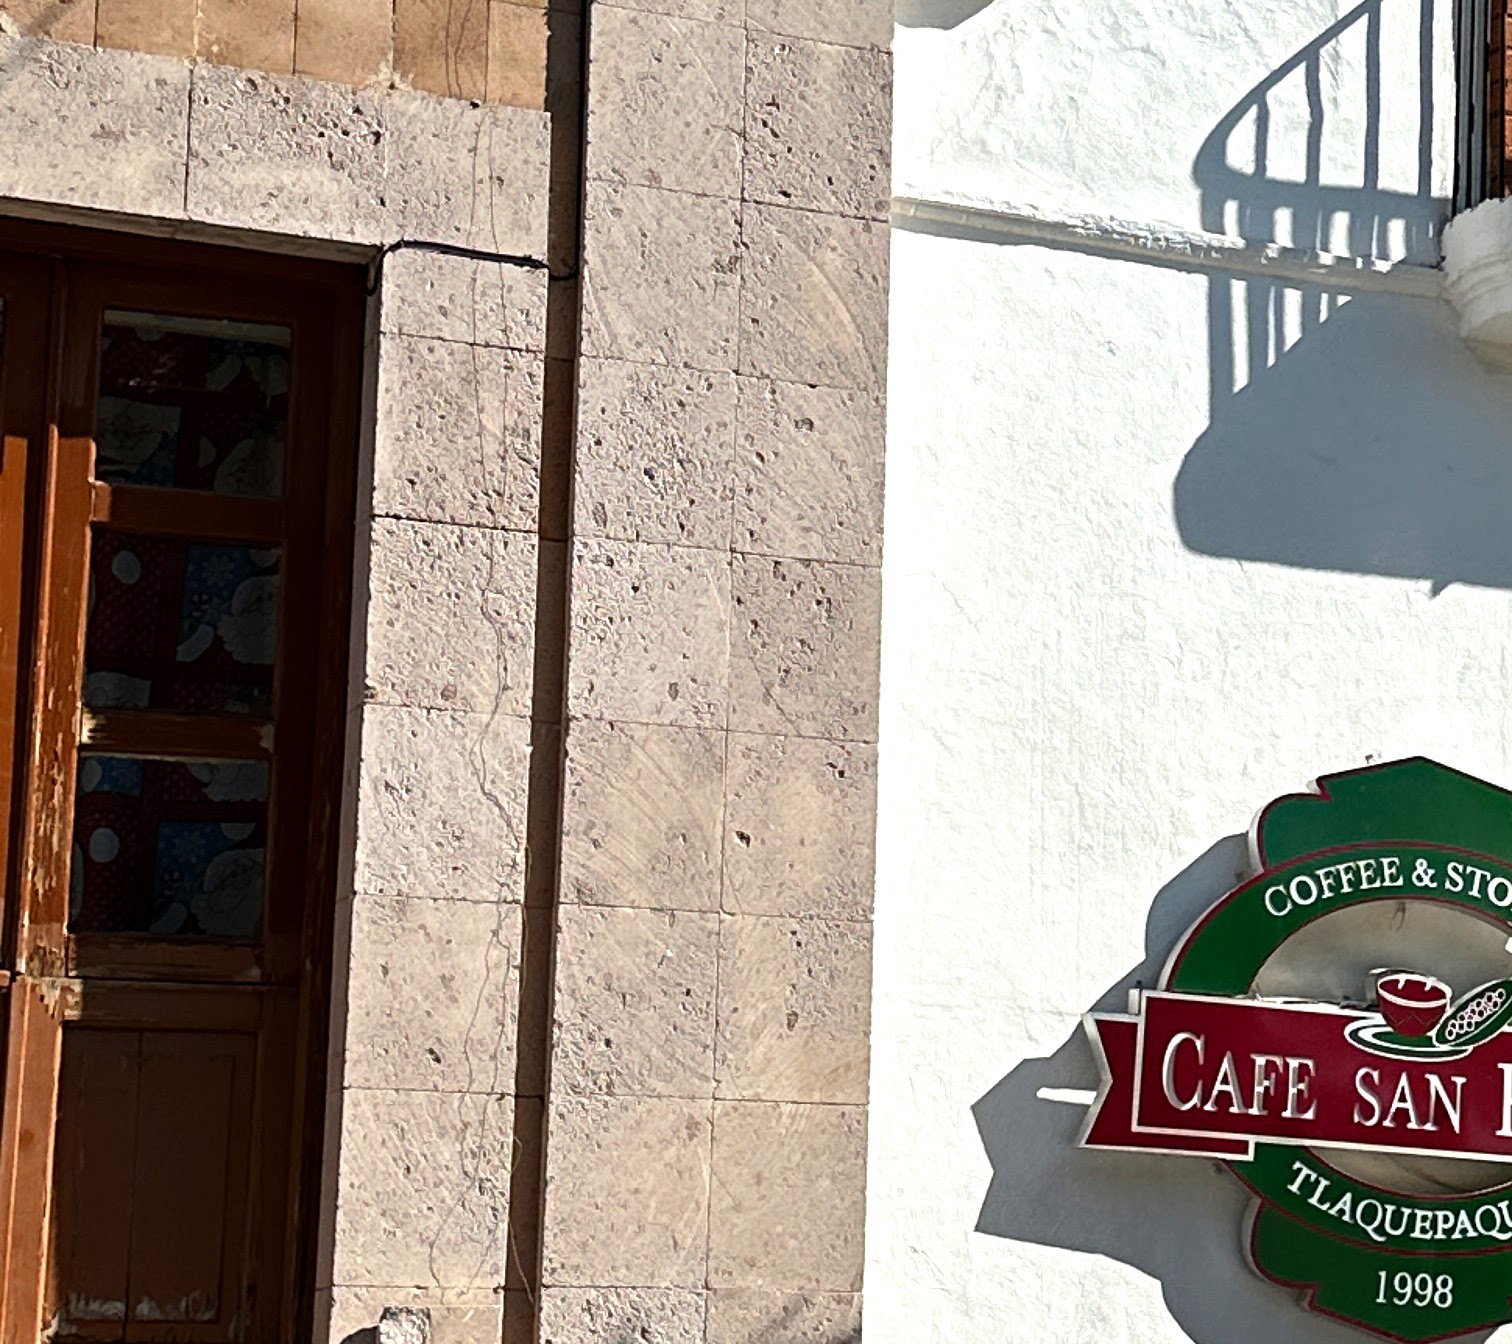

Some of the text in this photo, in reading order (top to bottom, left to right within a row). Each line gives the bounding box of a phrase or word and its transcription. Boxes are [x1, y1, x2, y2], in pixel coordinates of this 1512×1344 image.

[1264, 858, 1404, 917] COFFEE
[1413, 858, 1438, 888] &
[1161, 1031, 1317, 1120] CAFE
[1353, 1067, 1468, 1134] SAN
[1375, 1270, 1454, 1308] 1998
